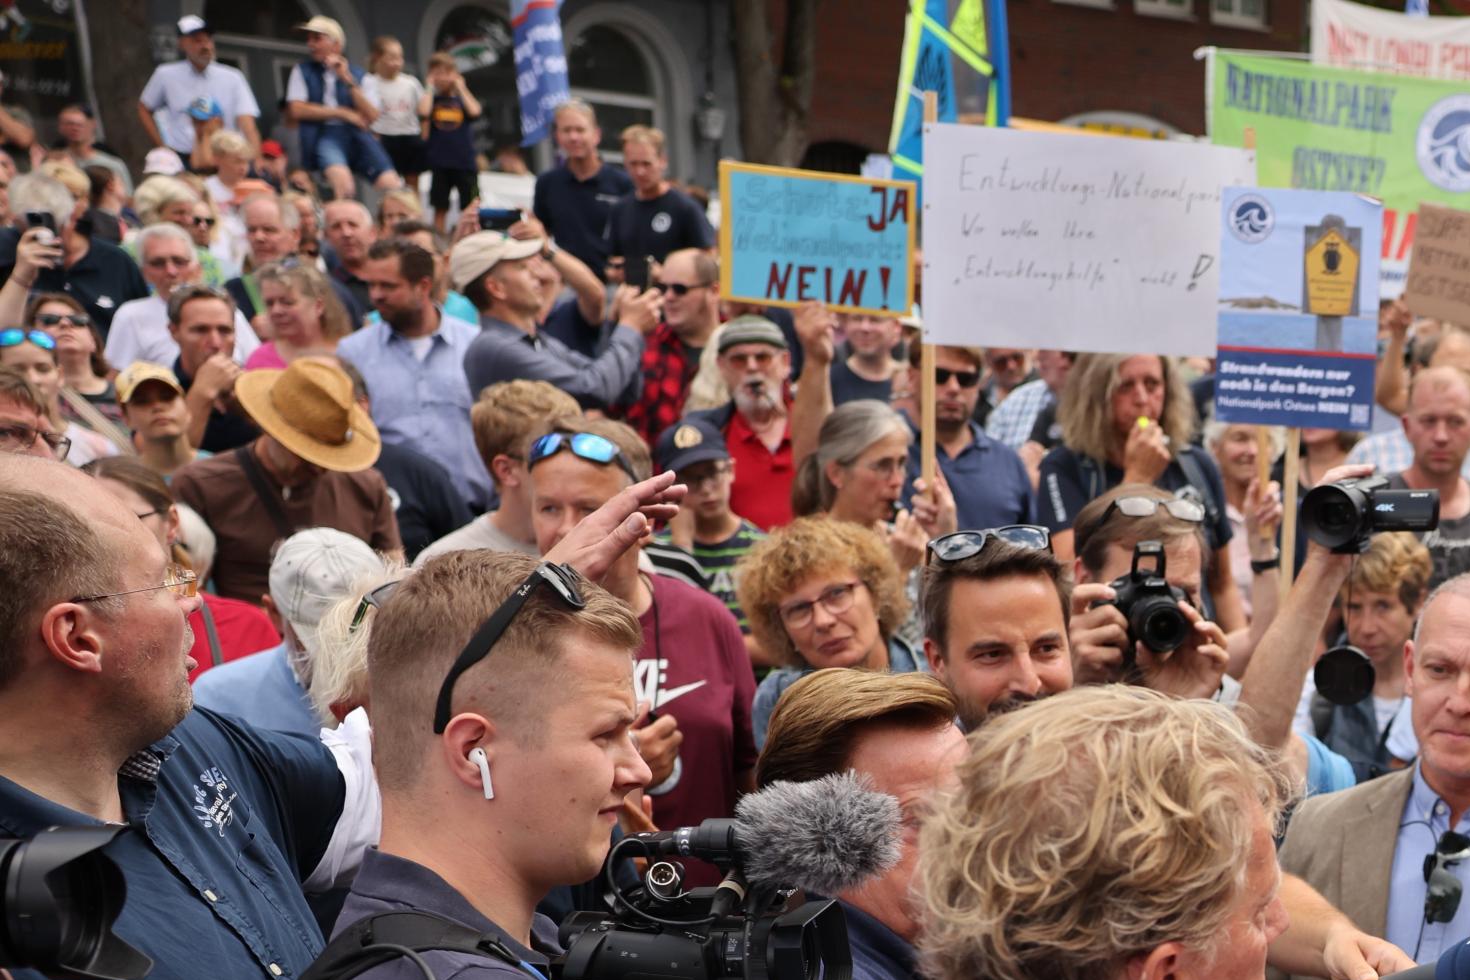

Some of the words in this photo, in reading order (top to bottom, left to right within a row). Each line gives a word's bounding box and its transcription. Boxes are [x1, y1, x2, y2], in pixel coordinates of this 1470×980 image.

[1224, 62, 1397, 134] NATIONALPARK
[866, 186, 910, 232] JA
[1220, 360, 1325, 380] Strandwandern
[1326, 370, 1351, 381] nur
[1219, 378, 1252, 392] noch
[1253, 379, 1267, 392] in
[1269, 380, 1295, 394] den
[1296, 382, 1355, 399] Bergen?
[1217, 395, 1282, 411] Nationalpark
[1283, 399, 1317, 412] Ostsee
[1317, 402, 1349, 414] NEIN
[1375, 503, 1395, 512] 4K
